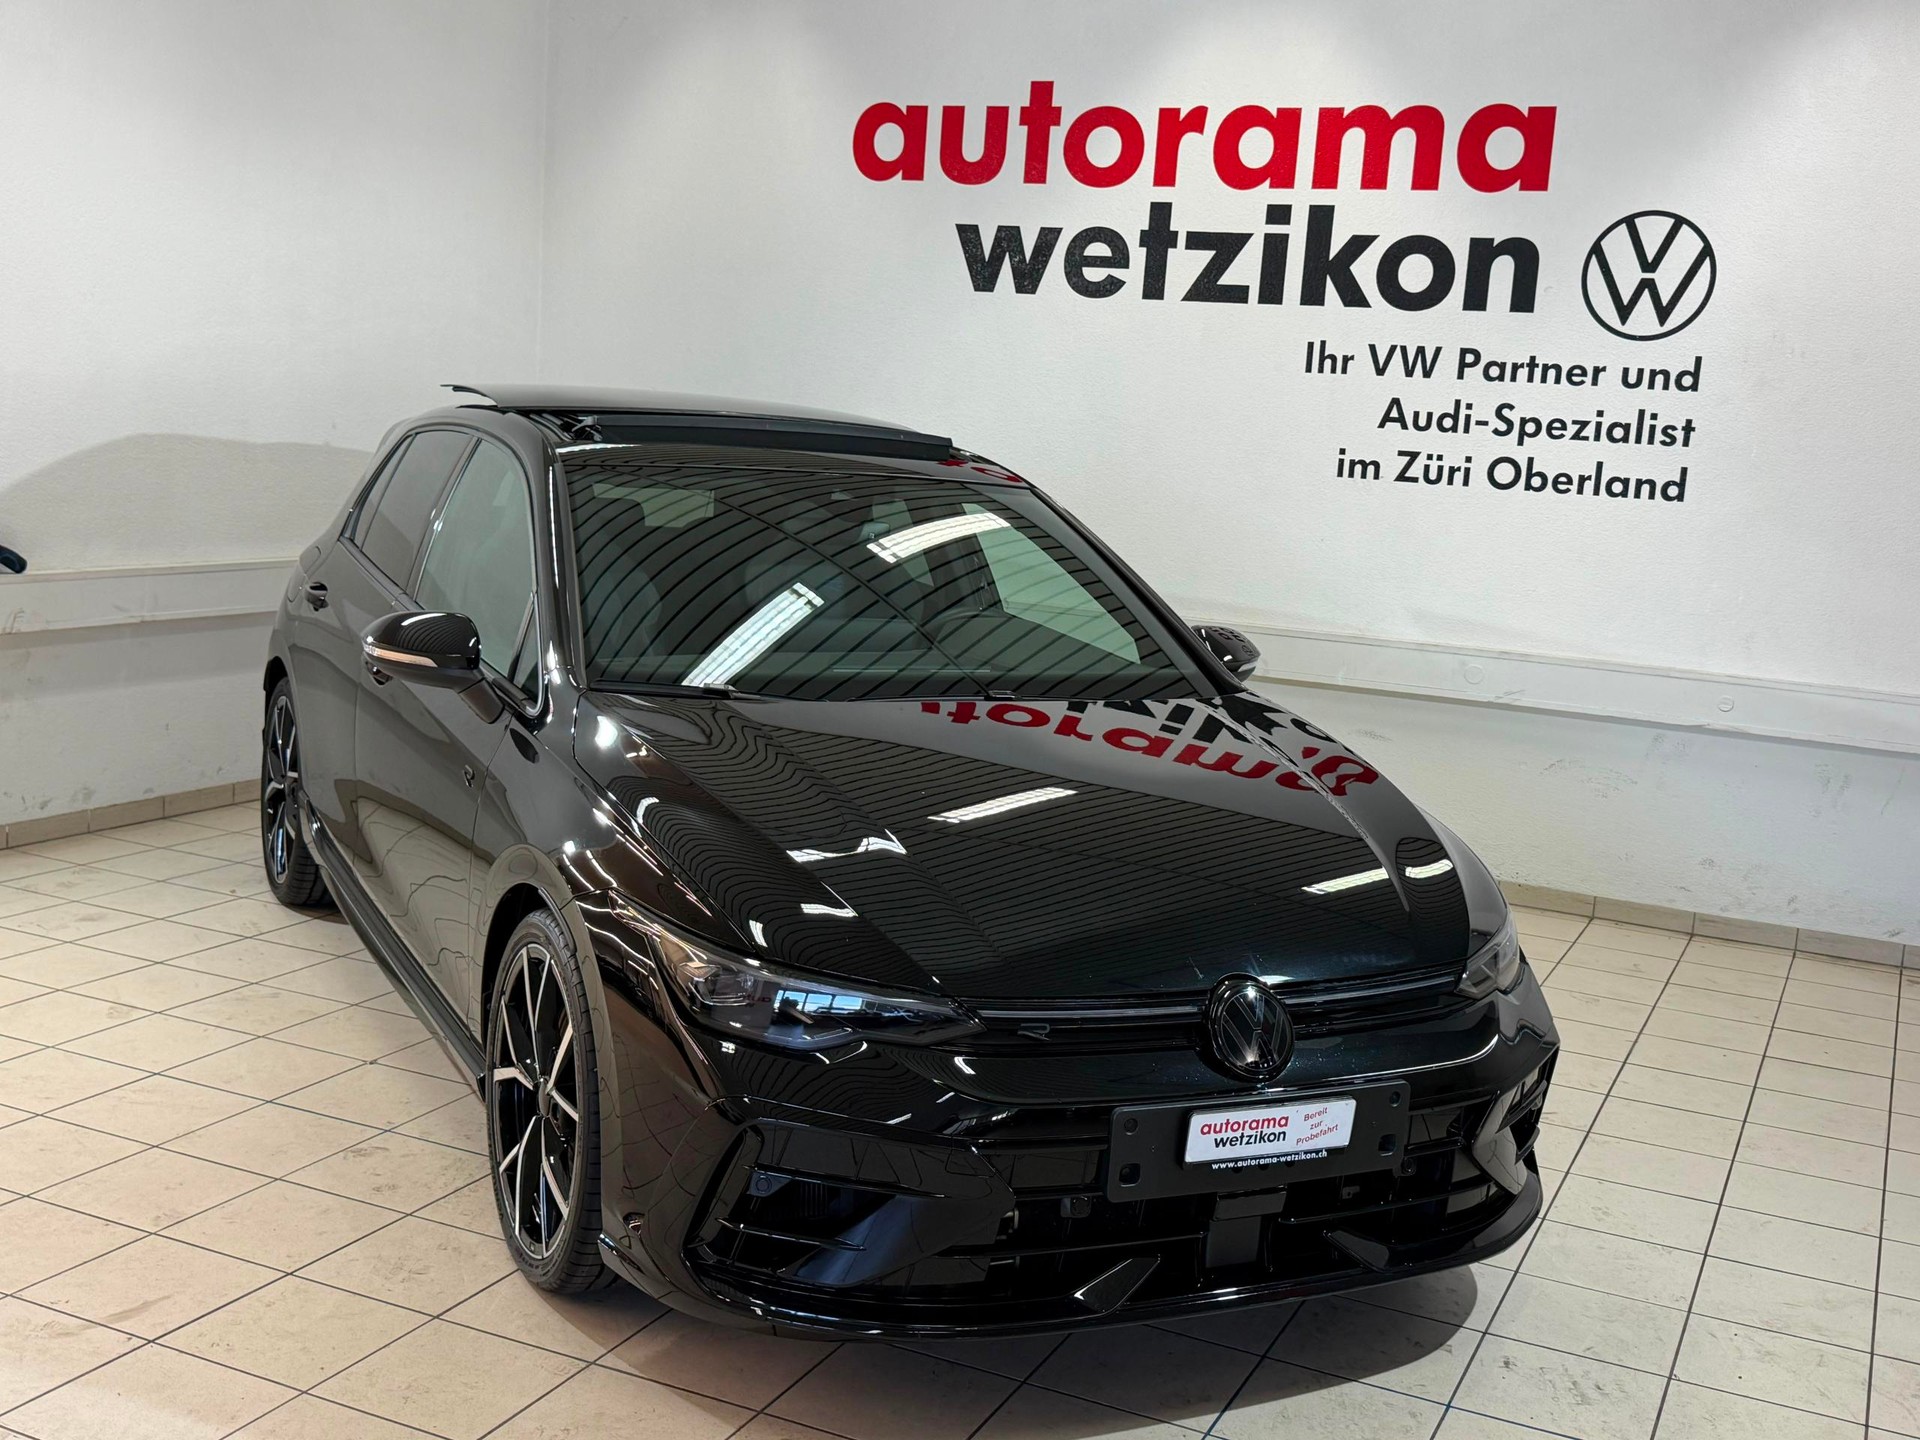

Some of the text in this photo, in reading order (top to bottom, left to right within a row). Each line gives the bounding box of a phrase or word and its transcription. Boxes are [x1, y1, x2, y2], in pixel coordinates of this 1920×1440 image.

[853, 81, 1556, 193] autorama
[956, 202, 1539, 313] wetzikon
[1306, 340, 1702, 391] Ihr VW Partner und
[1378, 398, 1695, 447] Audi-Spezialist
[1337, 448, 1687, 502] im Züri Oberland
[1200, 1115, 1289, 1135] autorama
[1303, 1107, 1328, 1122] Bereit
[1310, 1120, 1324, 1130] zur
[1214, 1130, 1287, 1148] wetzikon
[1296, 1124, 1339, 1146] Probefahrt
[1211, 1149, 1328, 1169] www.autorama-wetzikon.ch
